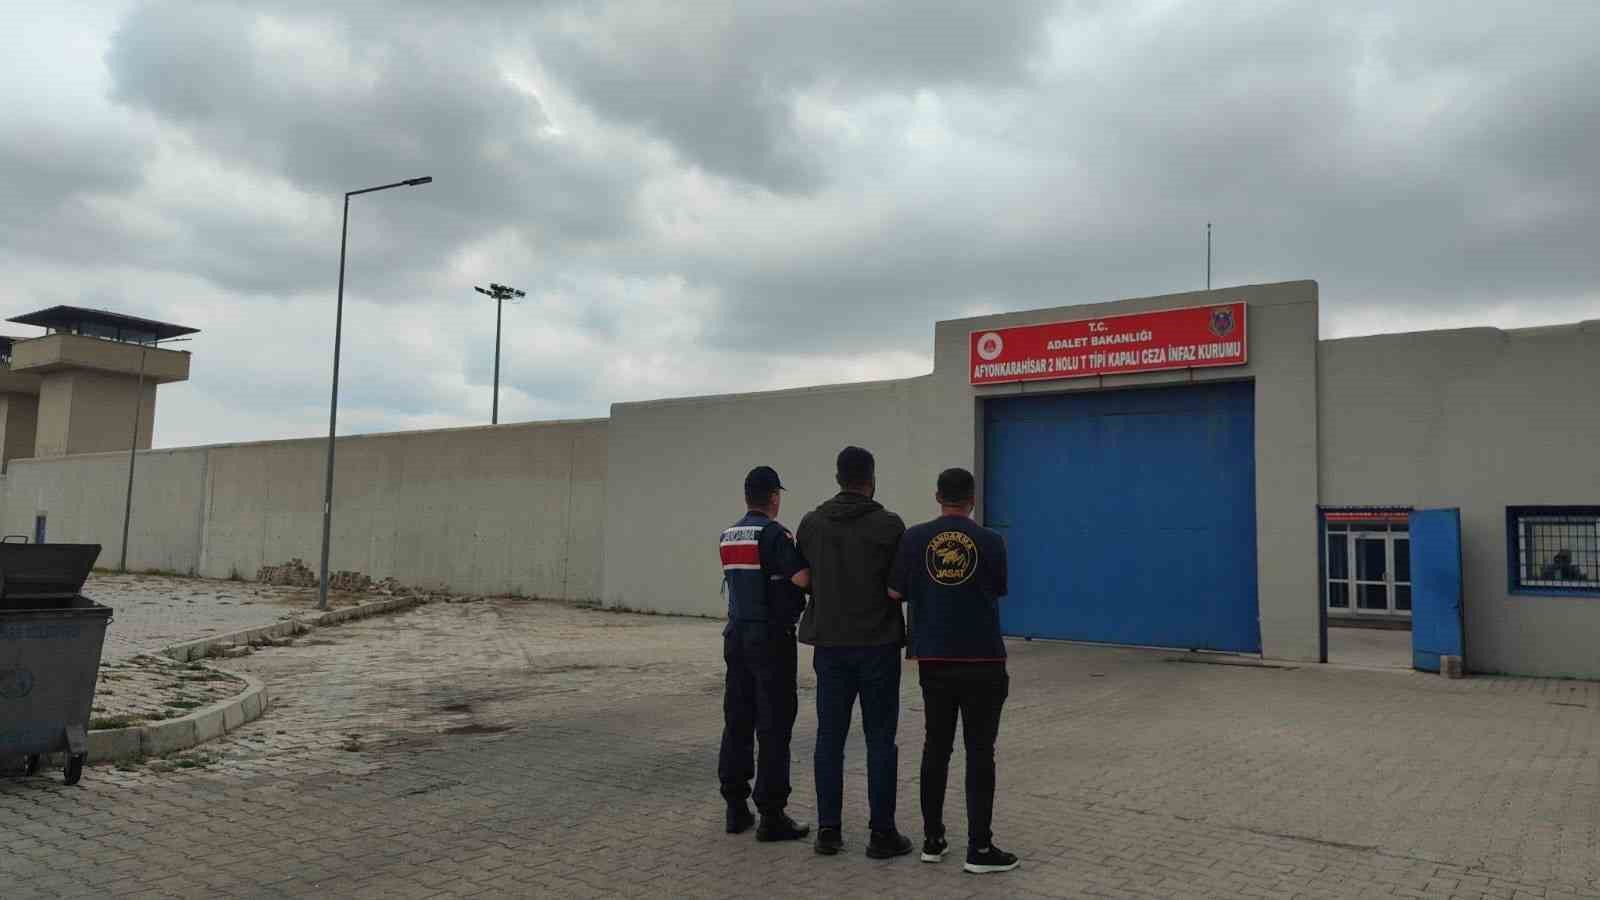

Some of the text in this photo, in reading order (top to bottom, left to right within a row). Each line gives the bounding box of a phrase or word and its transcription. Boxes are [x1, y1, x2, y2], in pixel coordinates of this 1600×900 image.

[1088, 322, 1108, 332] T.C.
[1047, 330, 1152, 350] ADALET BAKANLIĞI
[974, 341, 1241, 378] AFYONKARAHİSAR 2 NOLU T TİPİ KAPALI CEZA İNFAZ KURUMU
[936, 568, 964, 578] JASAT
